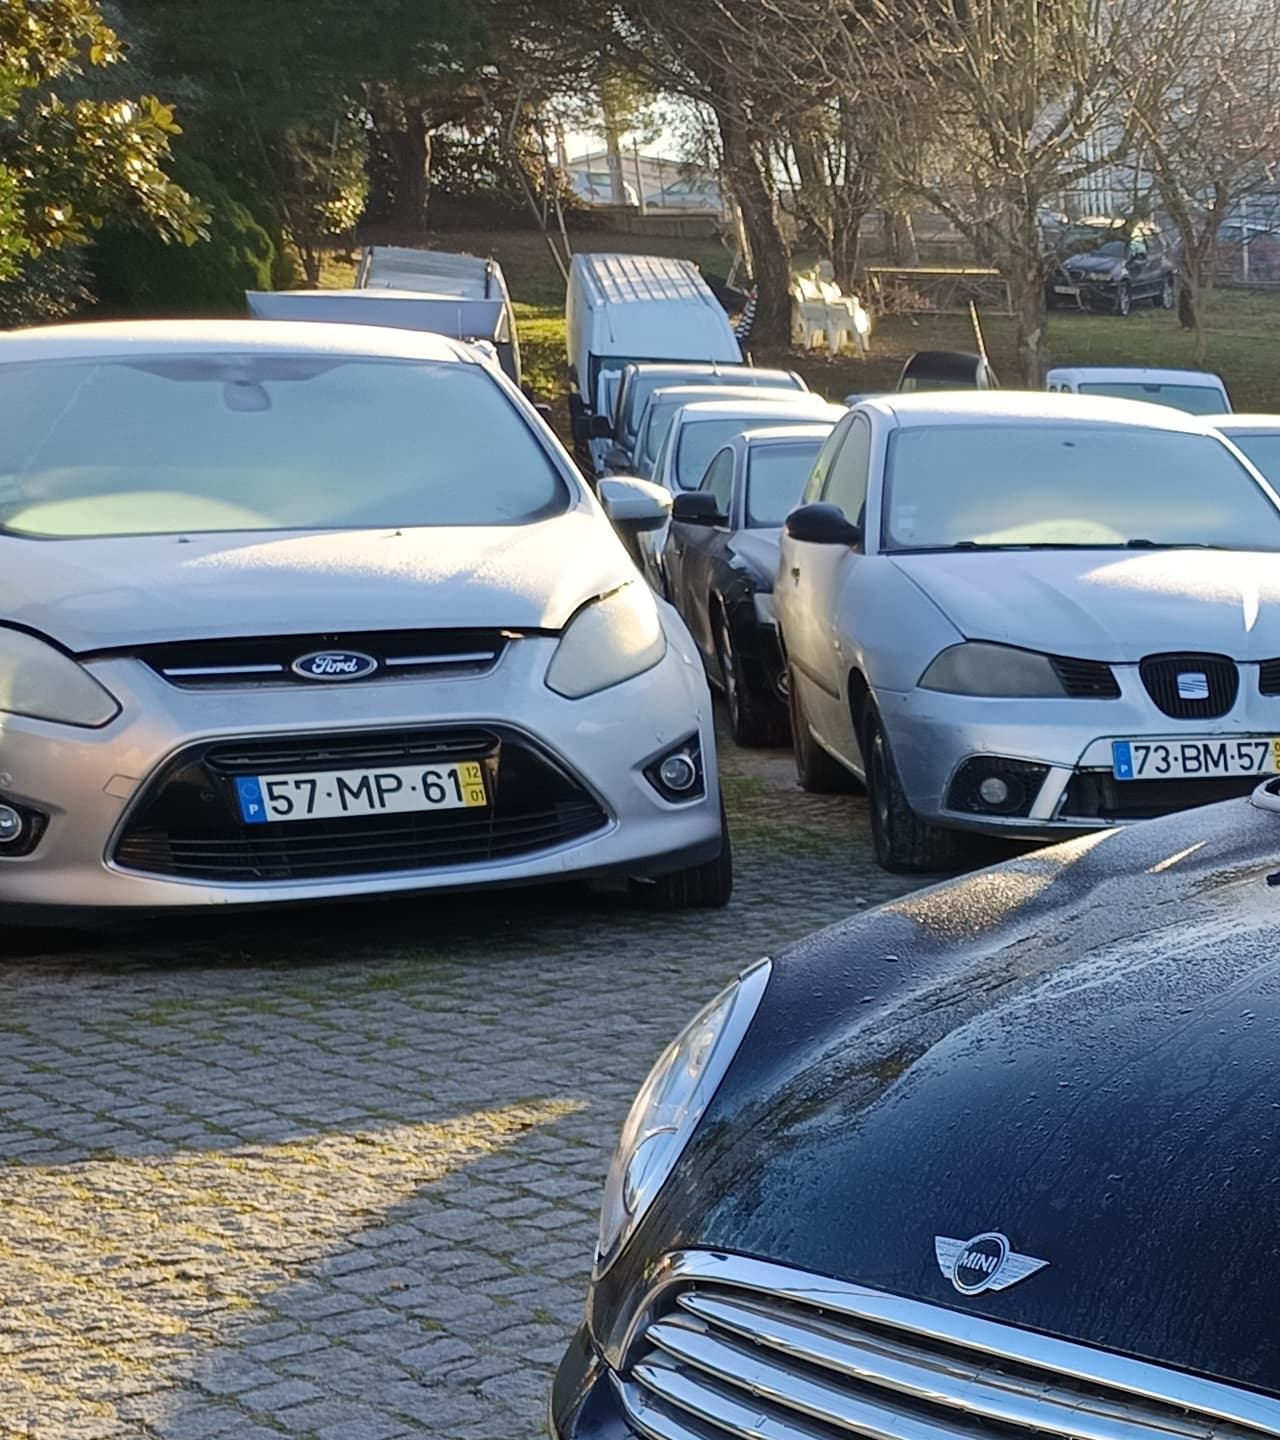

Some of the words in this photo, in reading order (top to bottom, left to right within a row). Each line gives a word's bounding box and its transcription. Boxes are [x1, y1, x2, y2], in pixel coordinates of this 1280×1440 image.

[311, 655, 358, 675] Ford
[466, 766, 481, 779] 12
[470, 789, 485, 802] 01
[249, 804, 259, 815] P
[959, 1250, 998, 1274] MINI
